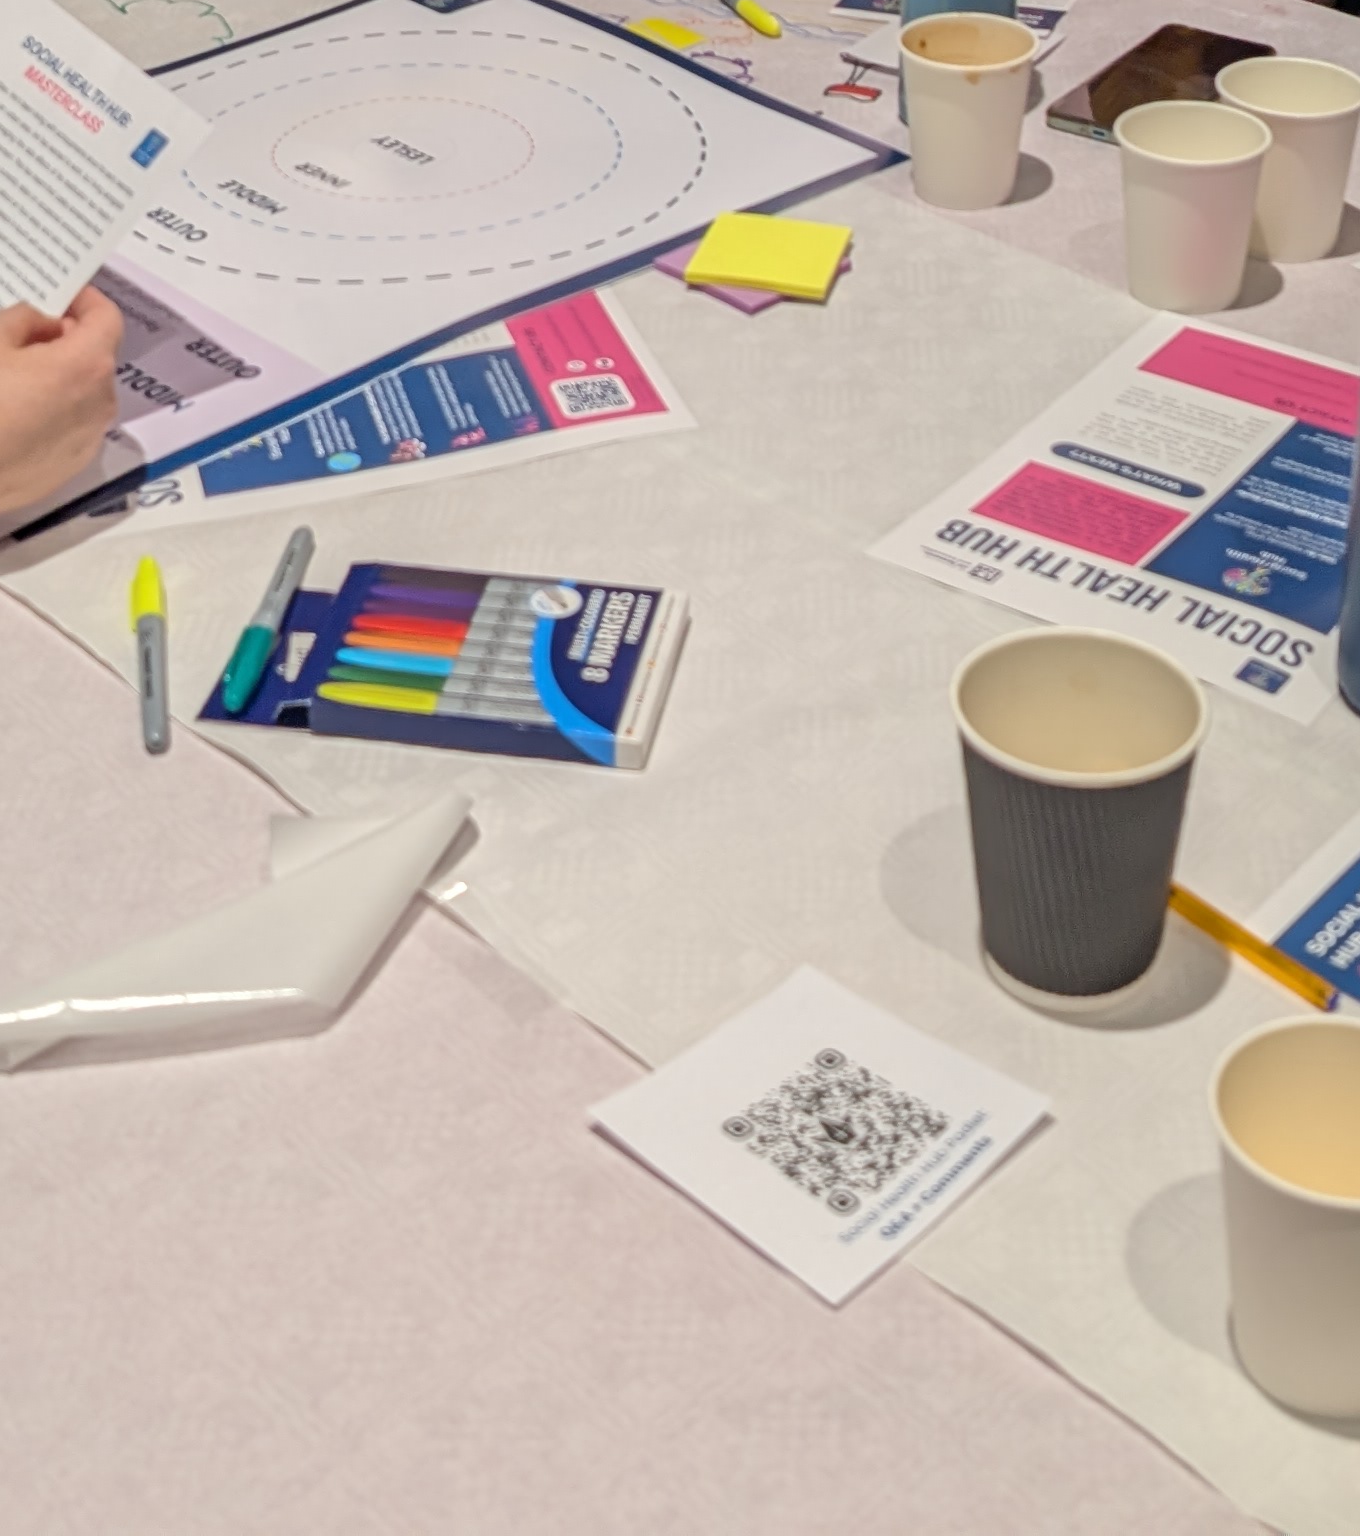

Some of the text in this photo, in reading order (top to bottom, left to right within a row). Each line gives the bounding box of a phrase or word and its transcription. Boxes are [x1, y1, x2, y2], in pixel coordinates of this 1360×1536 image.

[23, 35, 65, 75] SOCIAL
[62, 67, 111, 110] HEALTH
[24, 64, 105, 133] MASTERCLASS
[370, 135, 436, 165] LESLEY
[217, 179, 288, 215] MIDDLE
[294, 162, 352, 189] INNER
[146, 207, 208, 242] OUTER
[185, 337, 262, 379] OUTER
[1121, 463, 1182, 494] WHAT'S
[935, 517, 1020, 561] HUB
[1013, 545, 1173, 614] HEALTH
[580, 591, 635, 683] 8 MARKERS
[623, 593, 653, 645] PERMANENT
[1175, 594, 1315, 668] SOCIAL
[920, 1135, 993, 1205] Comments
